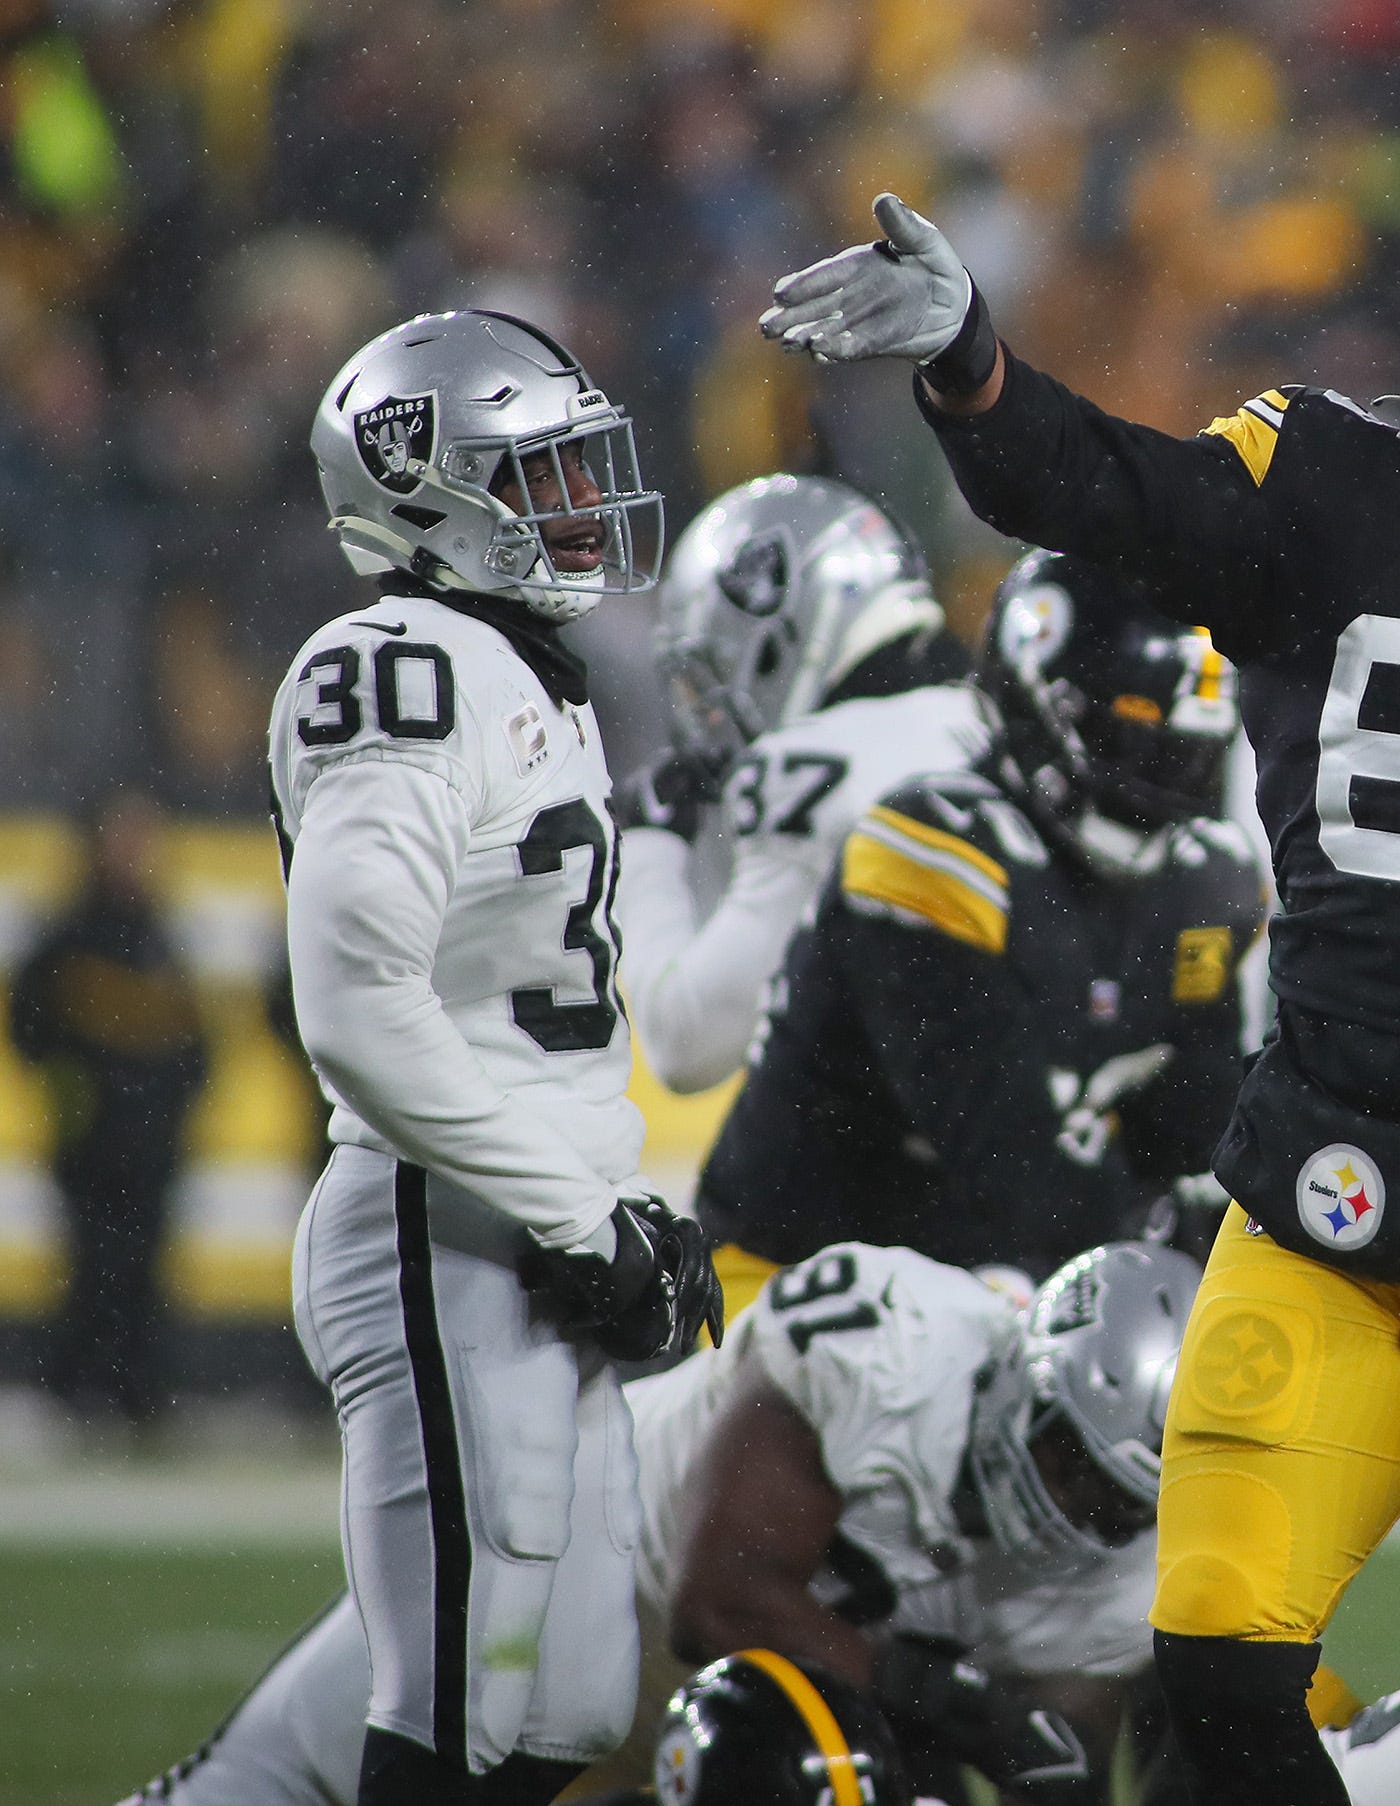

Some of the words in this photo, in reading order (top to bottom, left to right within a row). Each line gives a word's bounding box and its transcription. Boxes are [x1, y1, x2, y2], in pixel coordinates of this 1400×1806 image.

[360, 399, 425, 426] RAIDERS
[298, 640, 456, 747] 30
[736, 754, 849, 836] 37
[512, 796, 622, 1053] 3
[1308, 1180, 1339, 1199] Steelers
